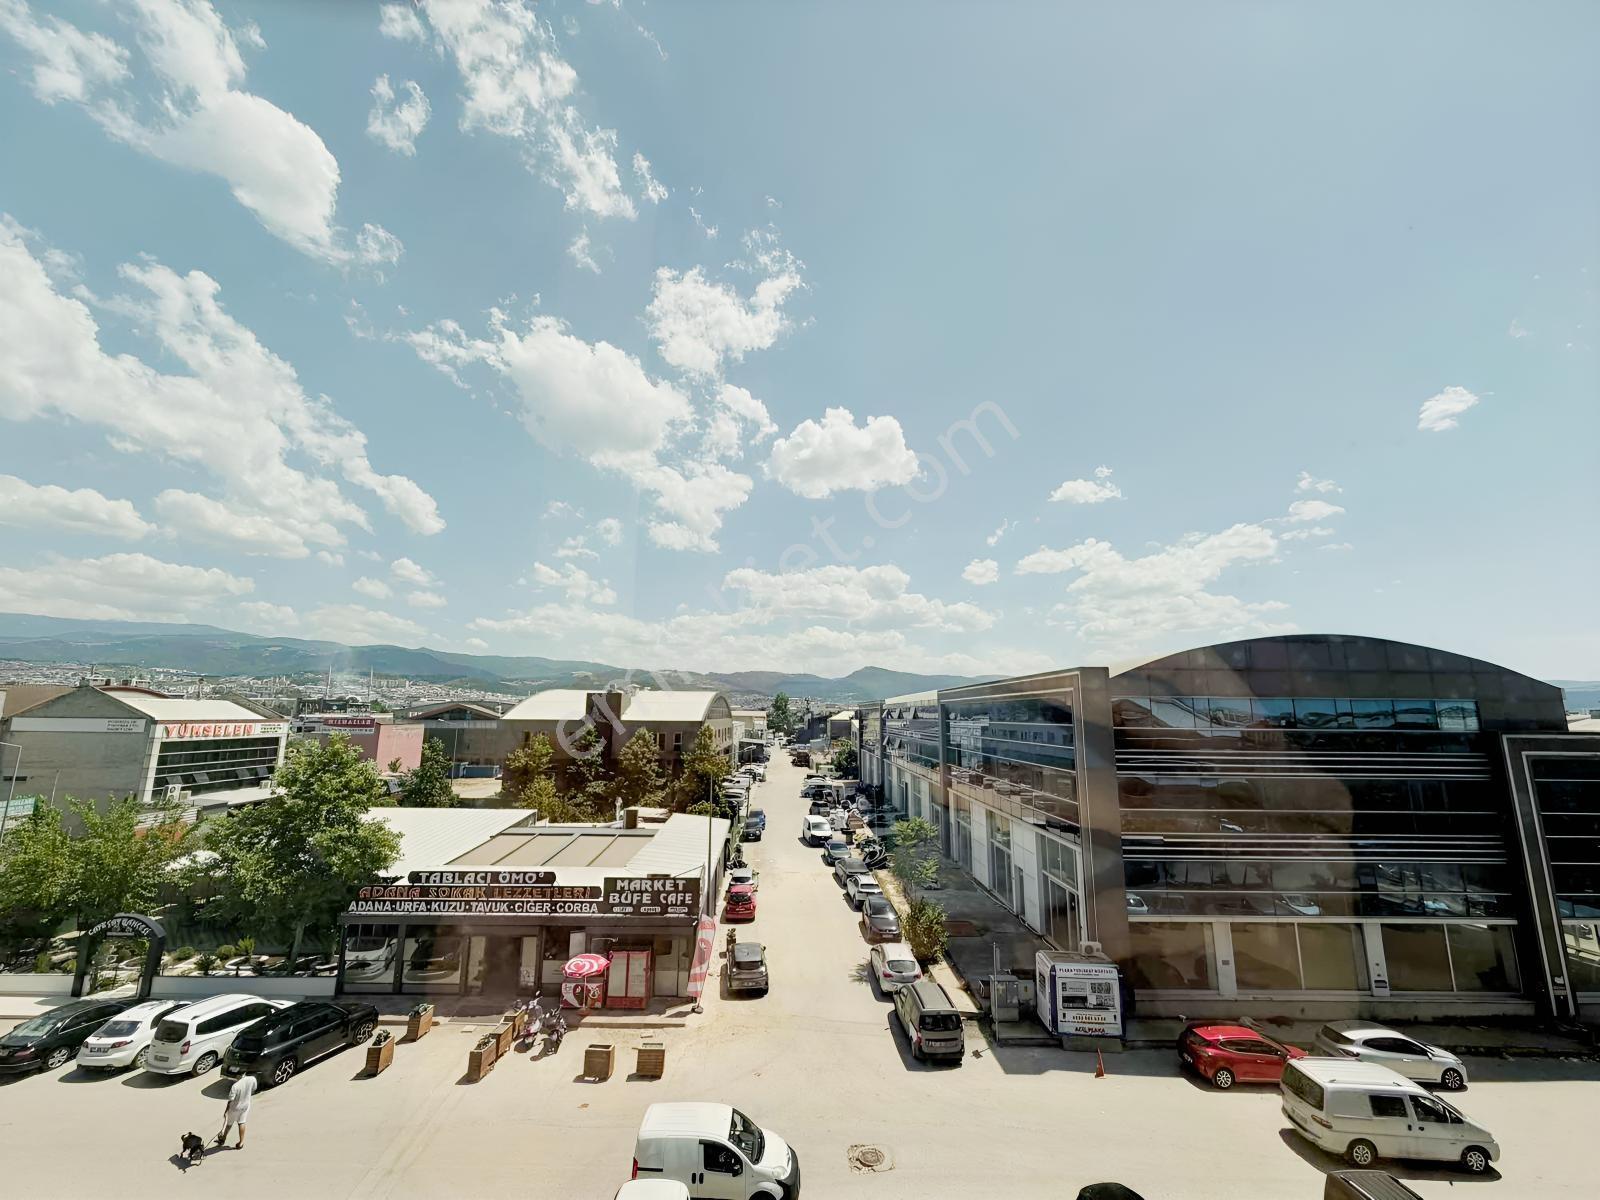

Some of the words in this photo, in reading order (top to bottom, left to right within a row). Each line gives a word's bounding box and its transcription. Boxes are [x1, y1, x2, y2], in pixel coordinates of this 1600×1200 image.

[418, 872, 491, 884] TABLACI
[616, 879, 687, 891] MARKET
[359, 886, 421, 899] ADANA
[428, 886, 486, 899] SOKAK
[608, 891, 652, 904] BÜFE
[659, 893, 693, 905] CAFE
[348, 901, 392, 912] ADANA
[395, 901, 426, 912] URFA
[430, 901, 466, 912] KUZU
[470, 901, 509, 912] TAVUK
